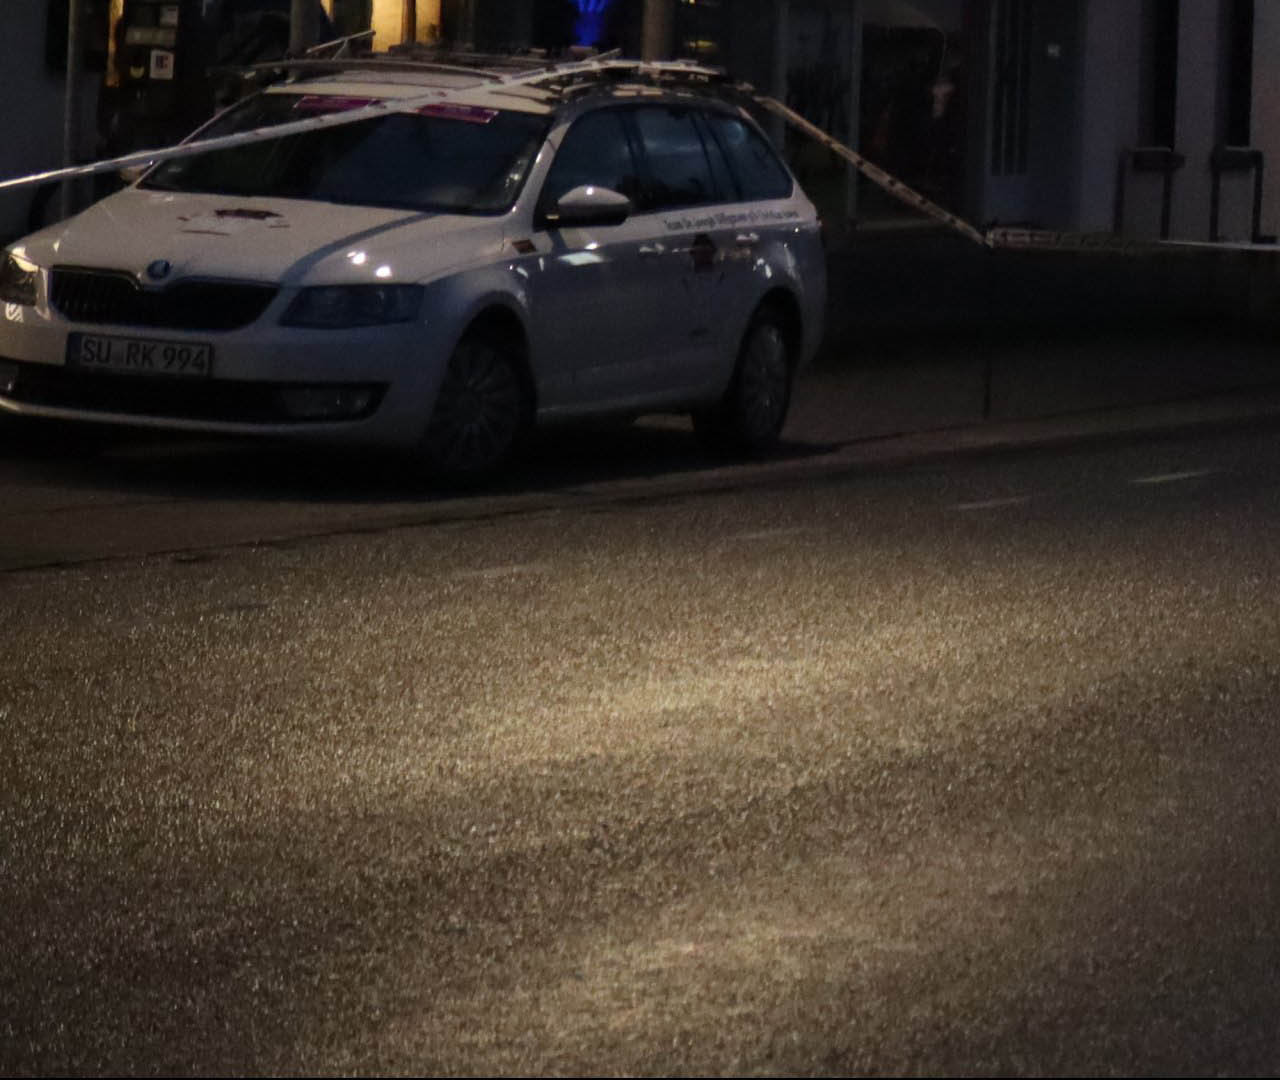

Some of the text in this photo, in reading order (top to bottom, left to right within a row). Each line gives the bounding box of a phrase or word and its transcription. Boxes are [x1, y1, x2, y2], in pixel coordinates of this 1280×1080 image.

[83, 339, 205, 370] SU RK 994
